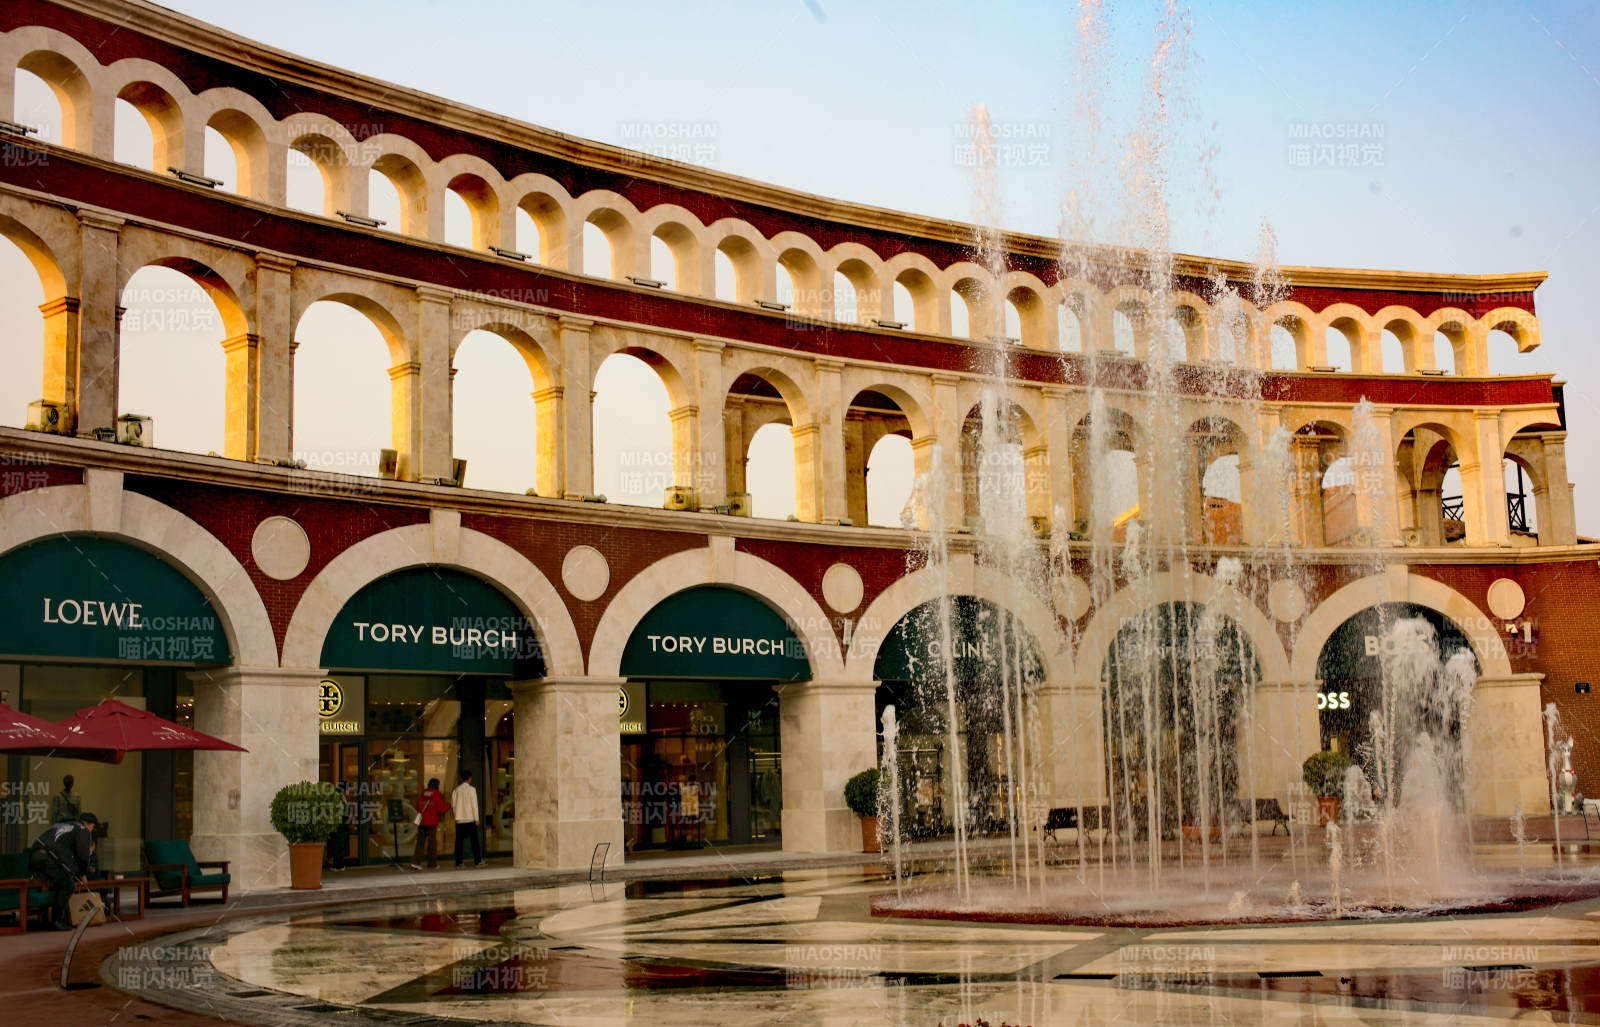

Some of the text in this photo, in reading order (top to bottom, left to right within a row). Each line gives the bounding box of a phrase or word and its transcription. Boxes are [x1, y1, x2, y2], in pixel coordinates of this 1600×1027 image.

[43, 598, 142, 628] LOEWE
[353, 622, 516, 648] TORY BURCH
[647, 635, 784, 655] TORY BURCH
[927, 641, 992, 658] CLINE
